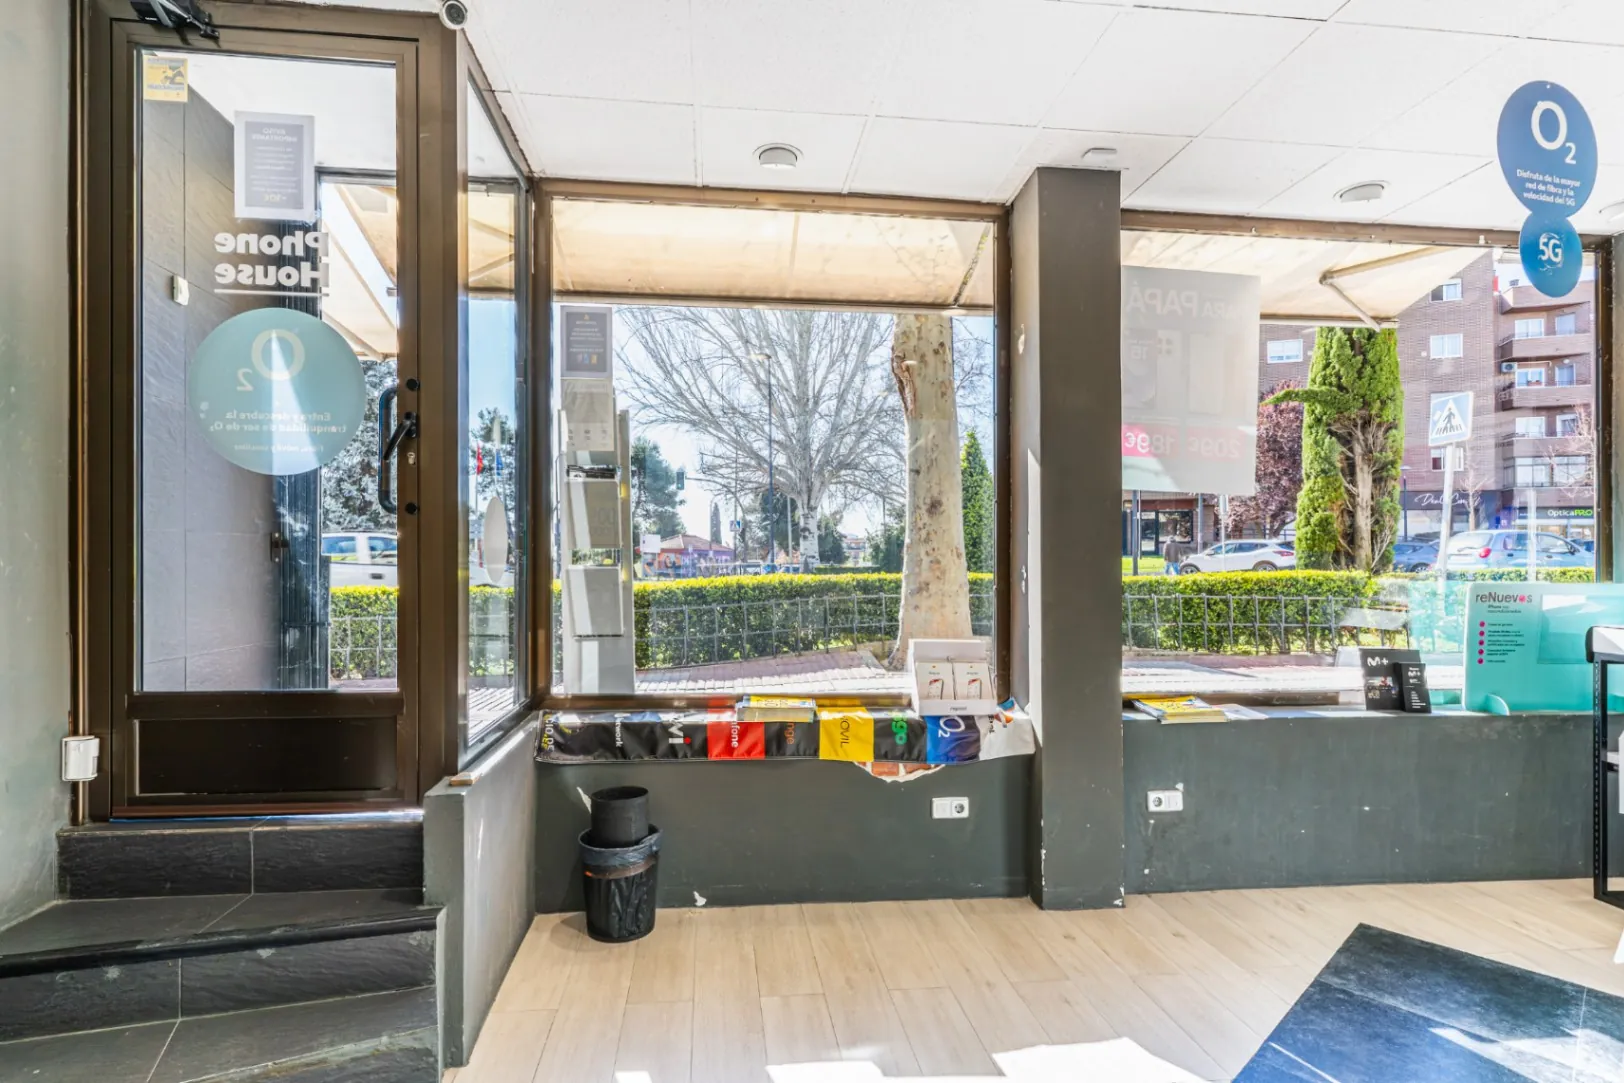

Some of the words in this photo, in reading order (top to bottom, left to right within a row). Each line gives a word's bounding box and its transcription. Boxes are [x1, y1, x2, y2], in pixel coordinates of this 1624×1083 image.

[1531, 100, 1577, 165] O2
[1516, 169, 1543, 181] Disfruta
[1553, 175, 1560, 184] la
[1560, 178, 1581, 188] mayor
[1525, 182, 1537, 190] red
[1537, 183, 1546, 191] de
[1546, 184, 1562, 194] fibra
[1567, 188, 1575, 196] la
[1523, 191, 1554, 203] velocidad
[1554, 196, 1565, 205] del
[1565, 197, 1576, 207] 5G
[1538, 236, 1563, 264] 5G
[1547, 509, 1593, 518] OpticaPRO
[1475, 591, 1533, 604] reNuevos
[938, 715, 966, 738] O2
